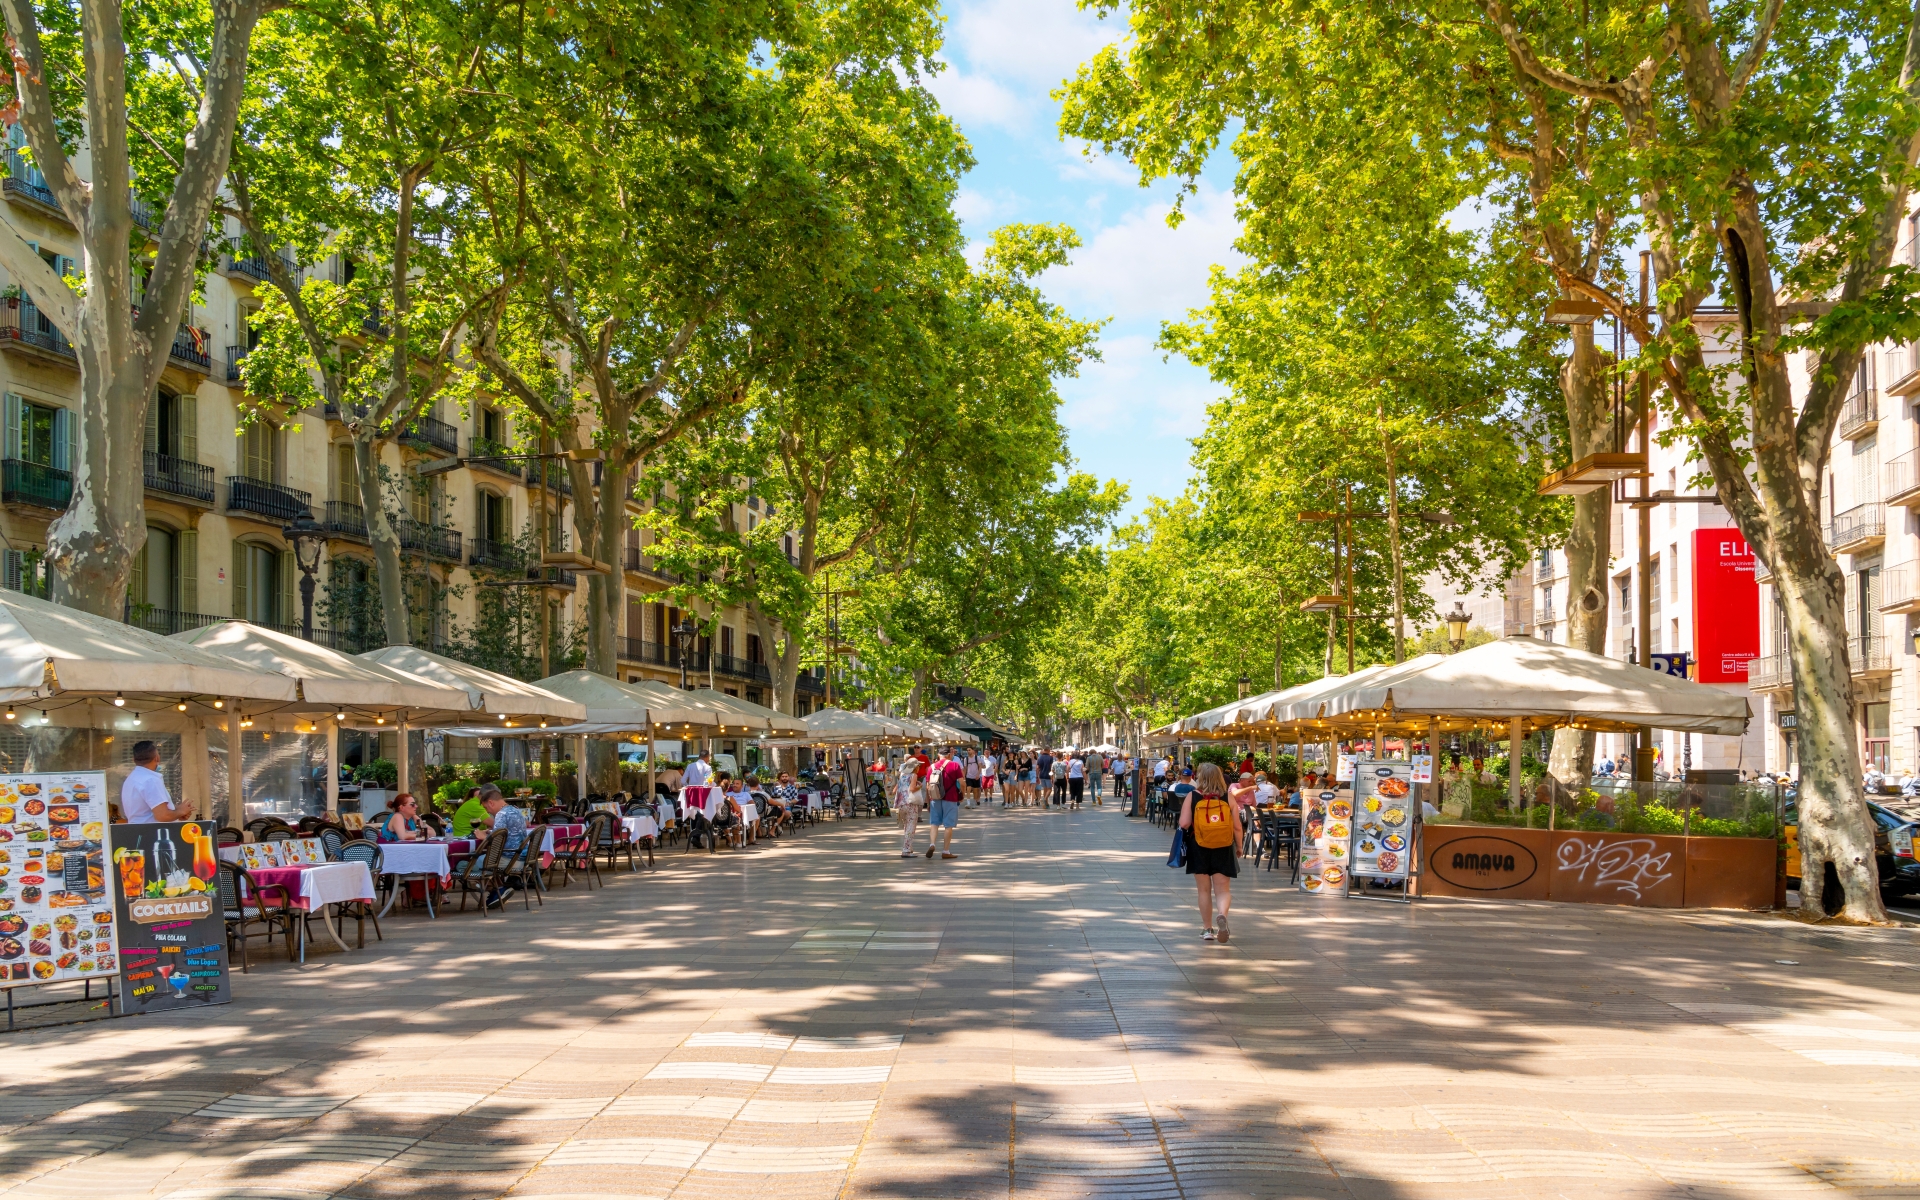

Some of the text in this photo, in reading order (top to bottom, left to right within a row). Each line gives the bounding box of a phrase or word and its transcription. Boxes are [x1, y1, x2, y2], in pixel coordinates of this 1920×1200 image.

[1719, 541, 1756, 557] ELI
[133, 901, 209, 917] COCKTAILS
[167, 934, 187, 942] COLADA
